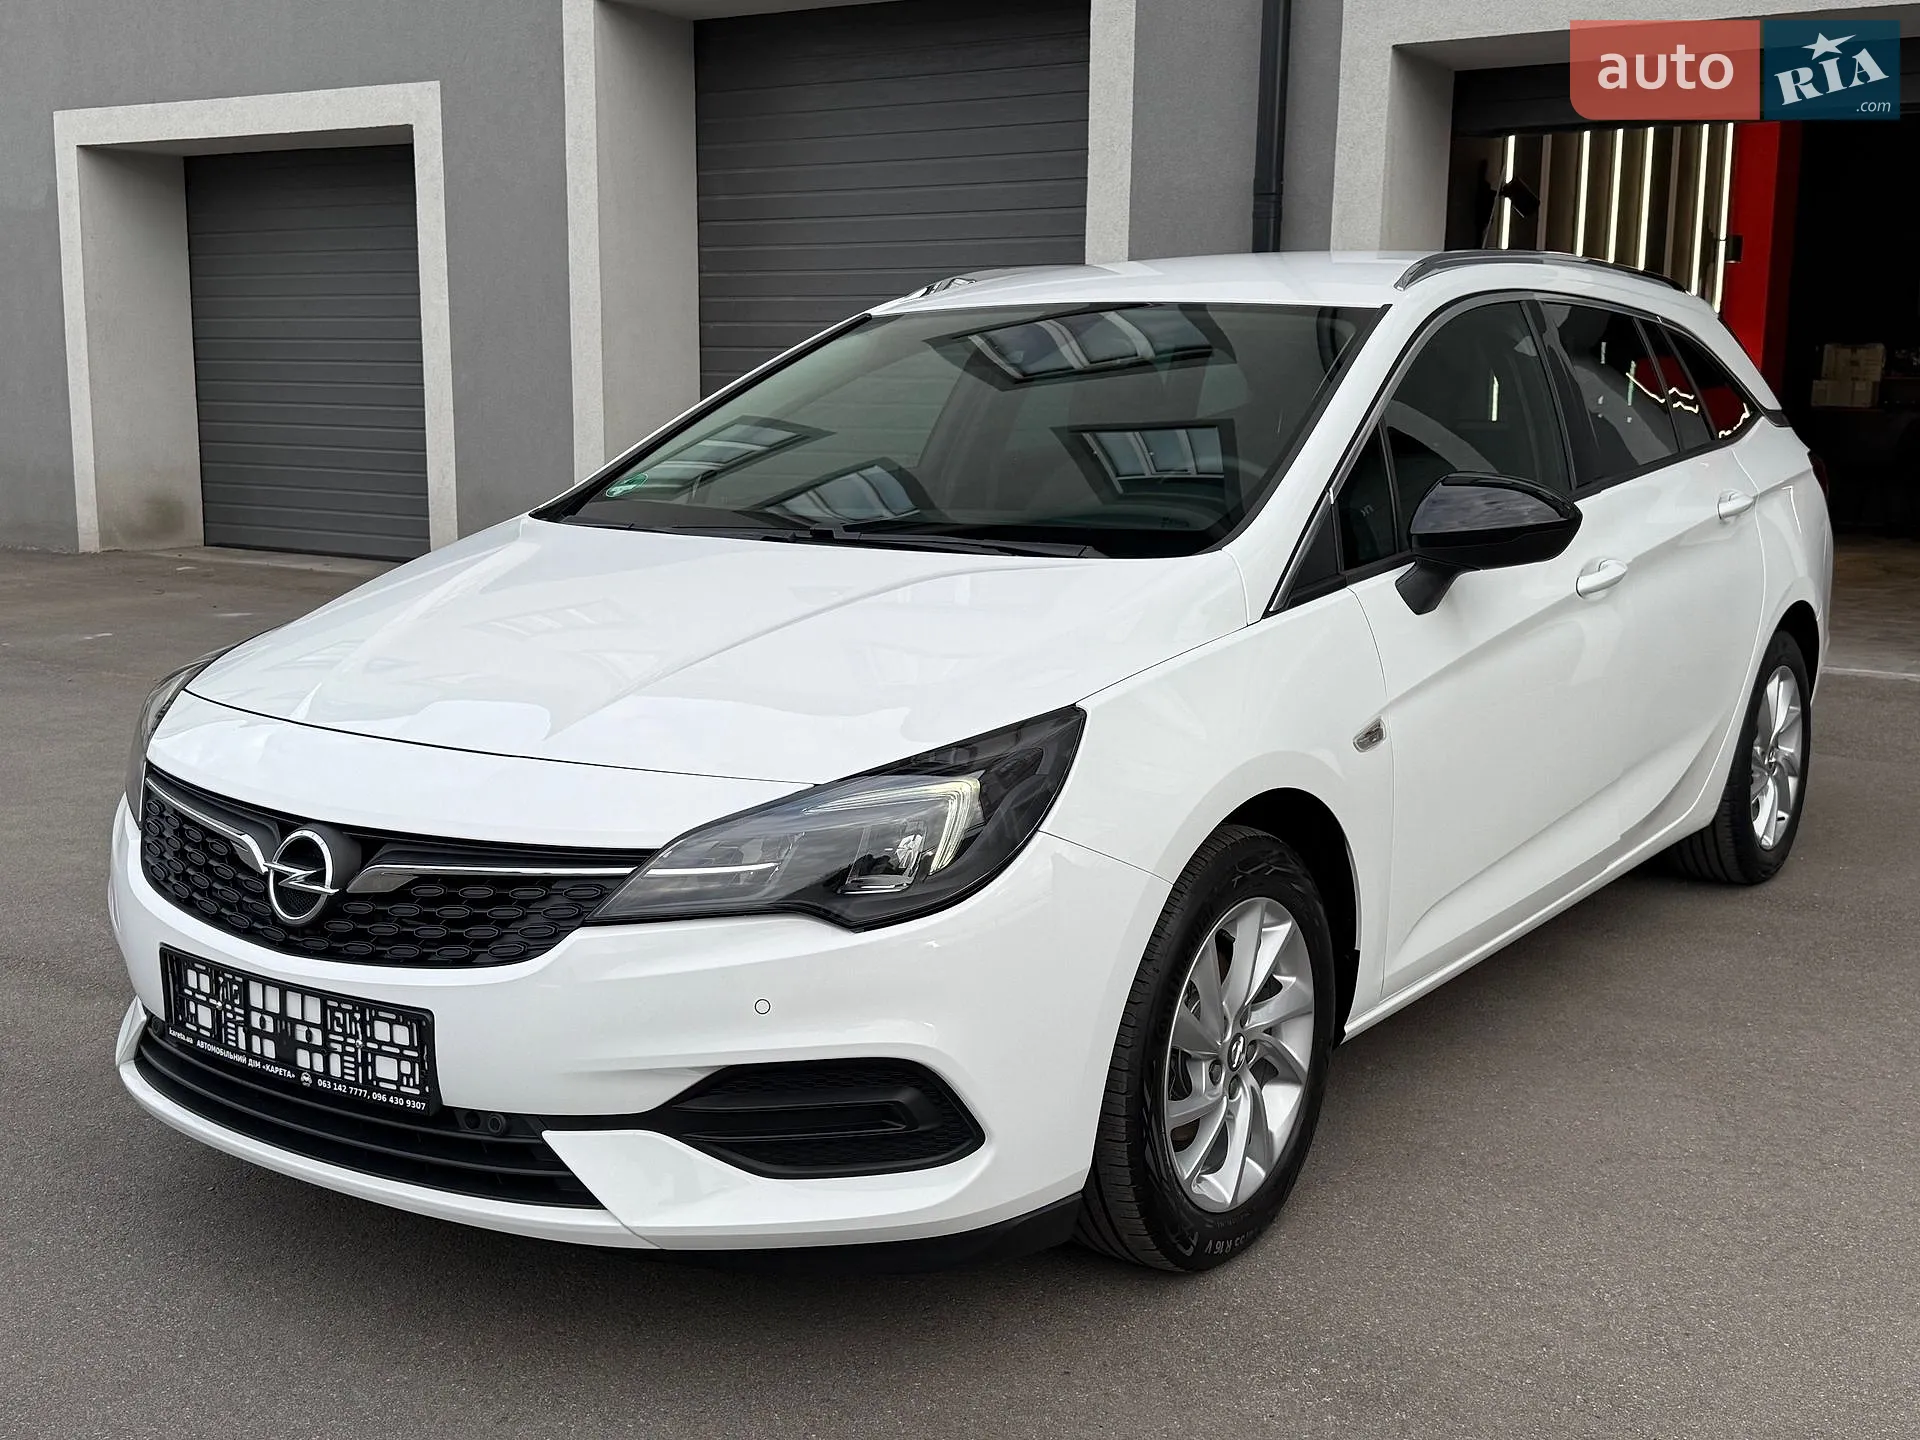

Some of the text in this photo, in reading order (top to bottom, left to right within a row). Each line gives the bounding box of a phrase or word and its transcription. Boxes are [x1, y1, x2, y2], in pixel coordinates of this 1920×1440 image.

[168, 1027, 194, 1044] kareta.ua
[196, 1040, 247, 1064] АВТОМОБІЛЬНИЙ
[248, 1058, 261, 1069] ДІМ
[317, 1079, 332, 1089] 063
[333, 1082, 347, 1093] 142
[349, 1087, 371, 1099] 7777,
[372, 1092, 387, 1102] 096
[389, 1095, 404, 1106] 430
[406, 1099, 426, 1111] 9307
